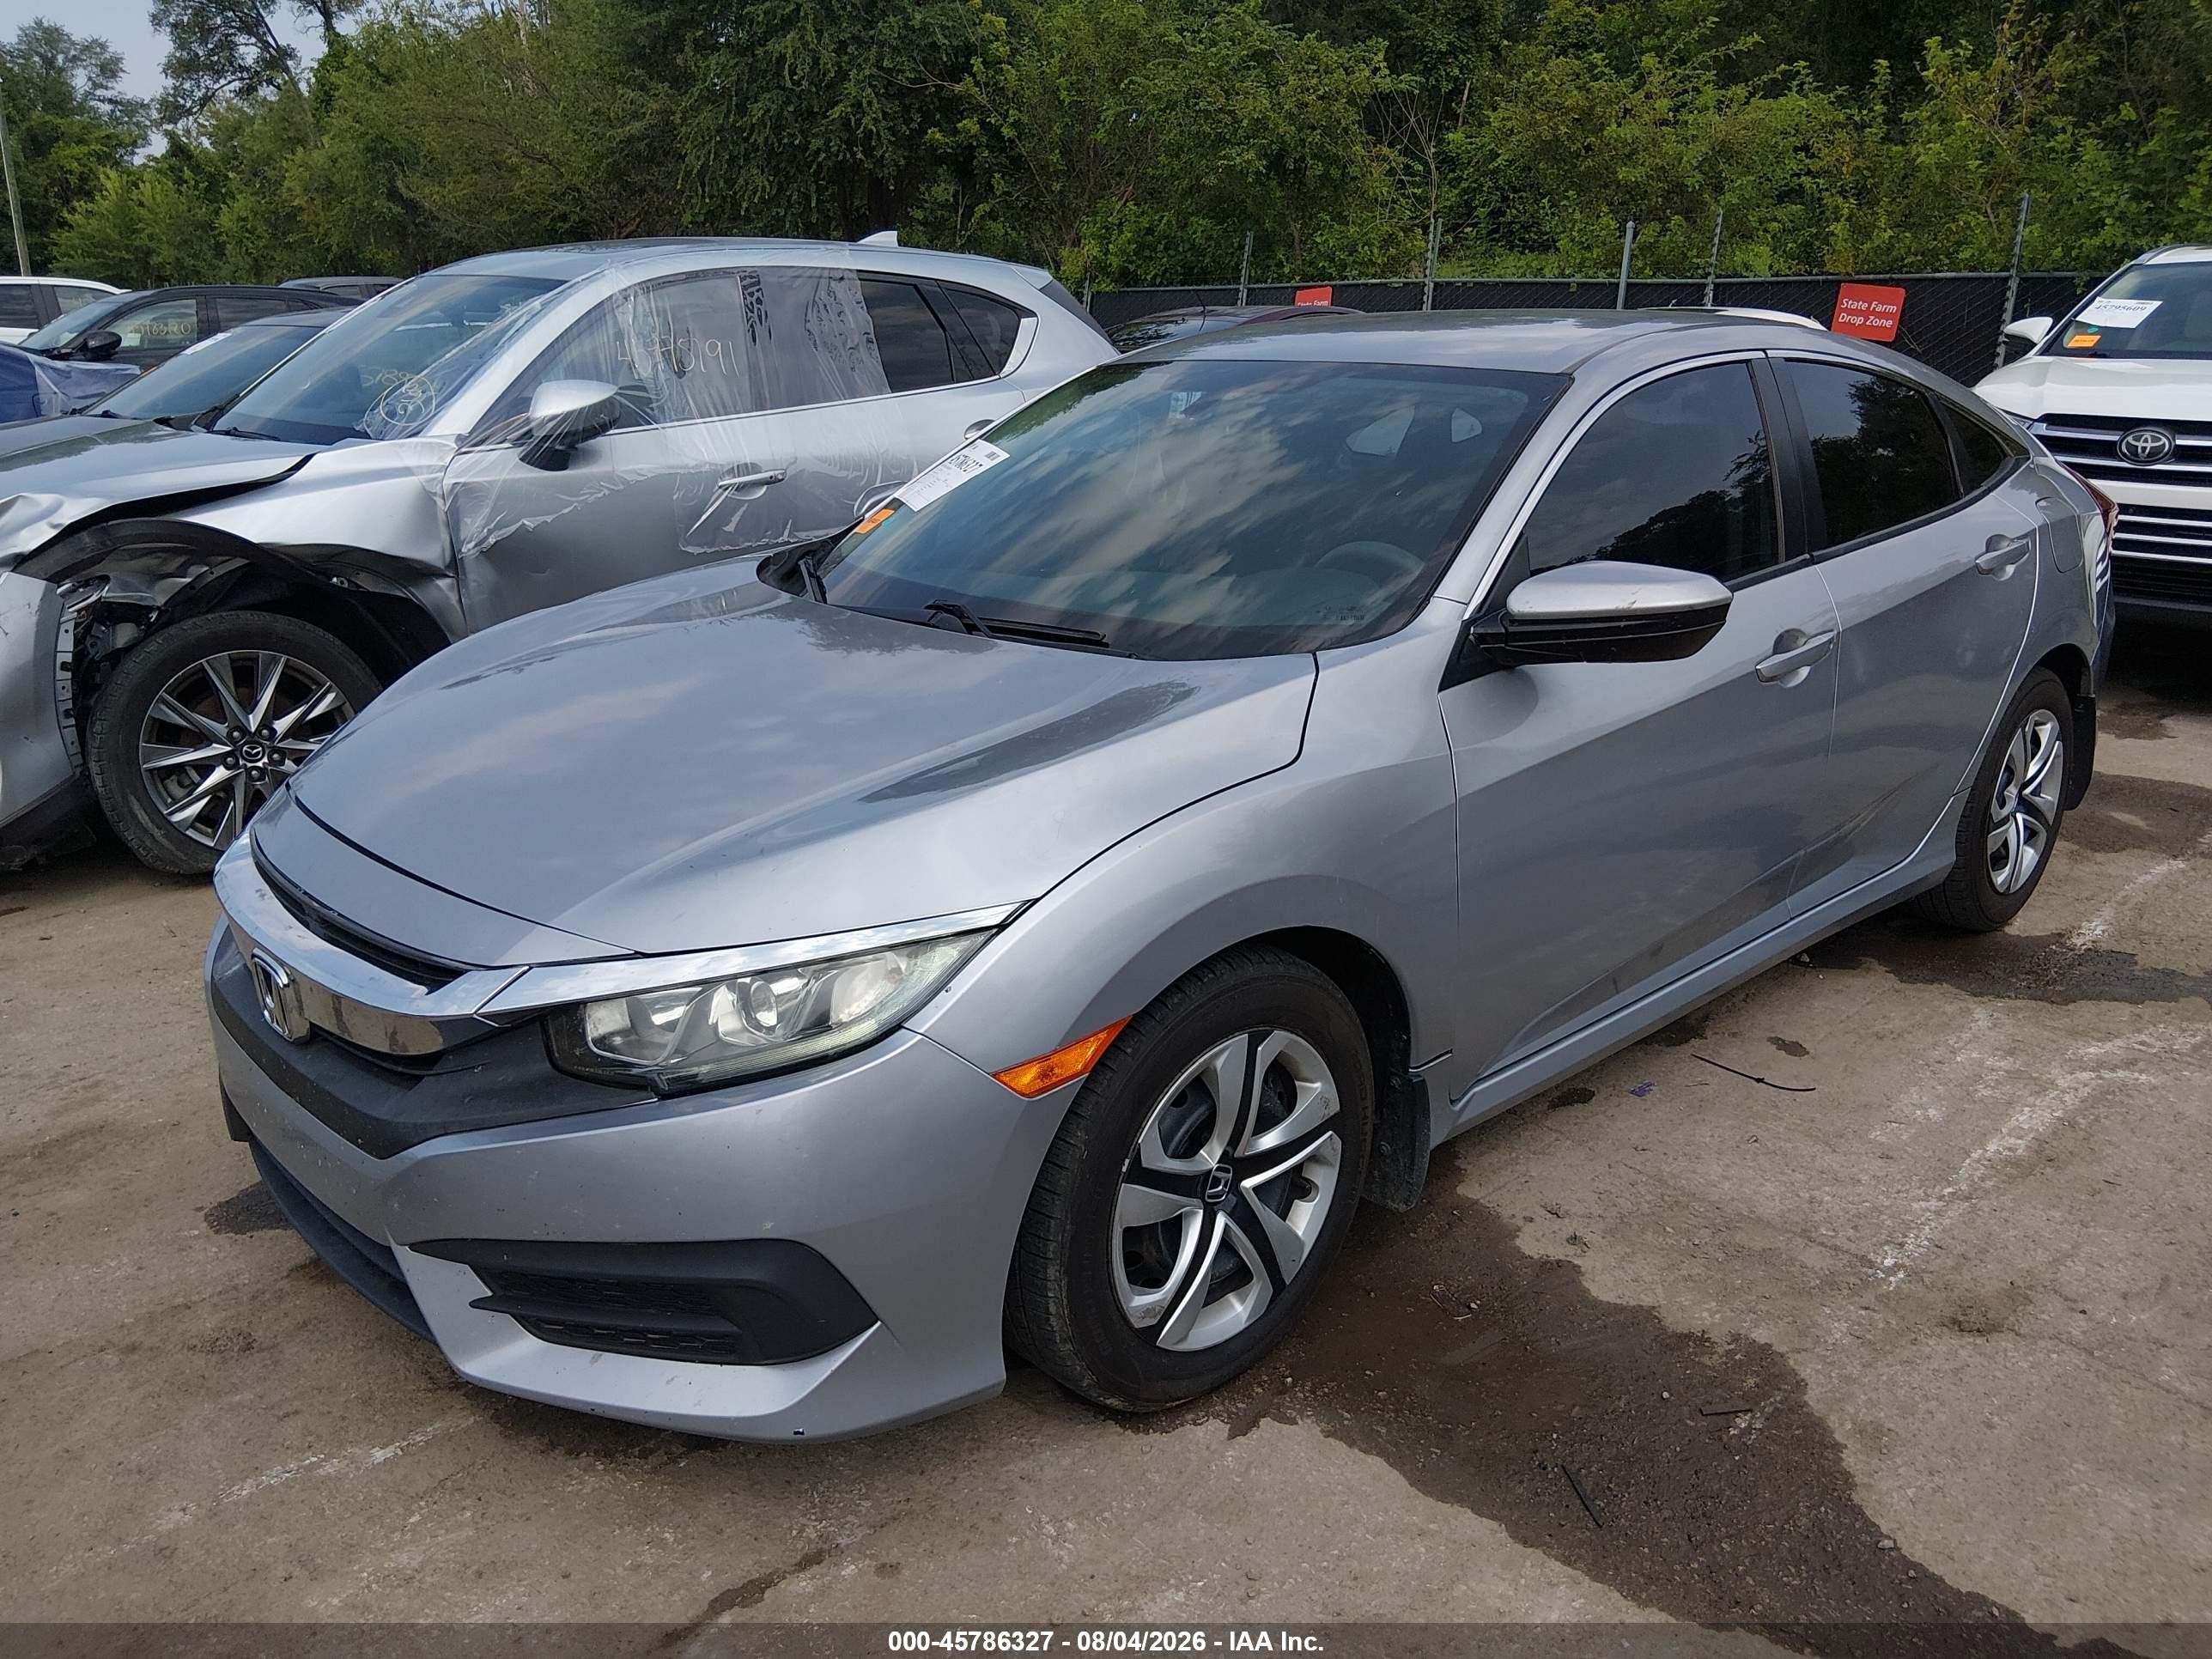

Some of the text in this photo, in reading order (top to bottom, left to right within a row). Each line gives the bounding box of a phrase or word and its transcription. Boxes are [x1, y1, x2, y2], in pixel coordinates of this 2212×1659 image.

[1840, 298, 1897, 313] State Farm
[1838, 313, 1893, 328] Drop Zone
